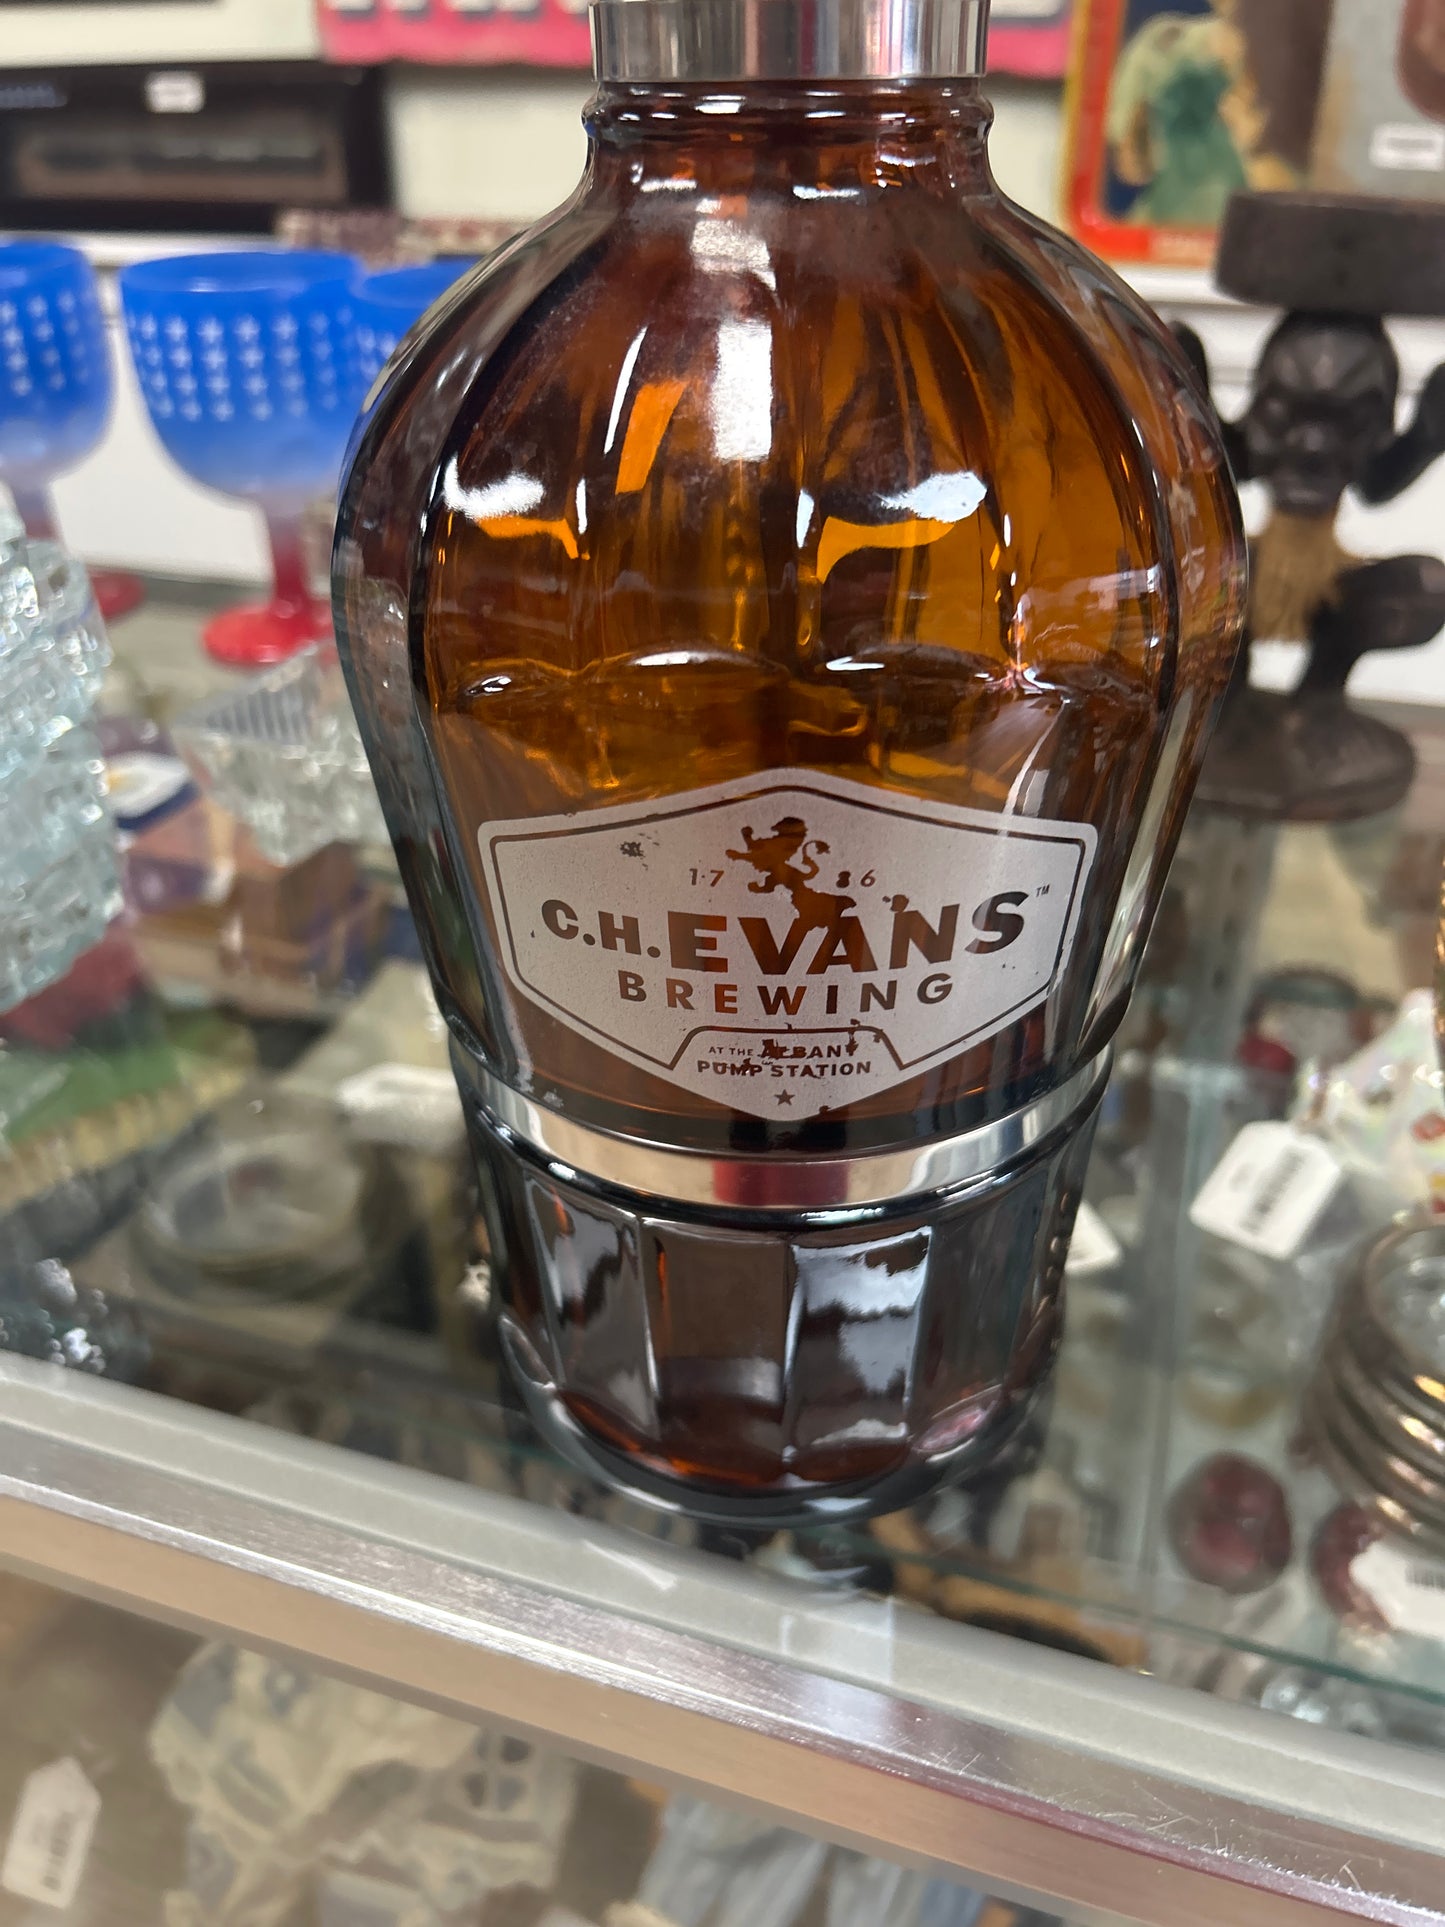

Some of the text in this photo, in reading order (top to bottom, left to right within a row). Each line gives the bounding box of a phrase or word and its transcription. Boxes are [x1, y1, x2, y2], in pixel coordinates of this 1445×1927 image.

[618, 970, 953, 1015] BREWING
[709, 1046, 724, 1054] AT
[729, 1047, 754, 1056] THE
[697, 1060, 872, 1078] PUMP STATION
